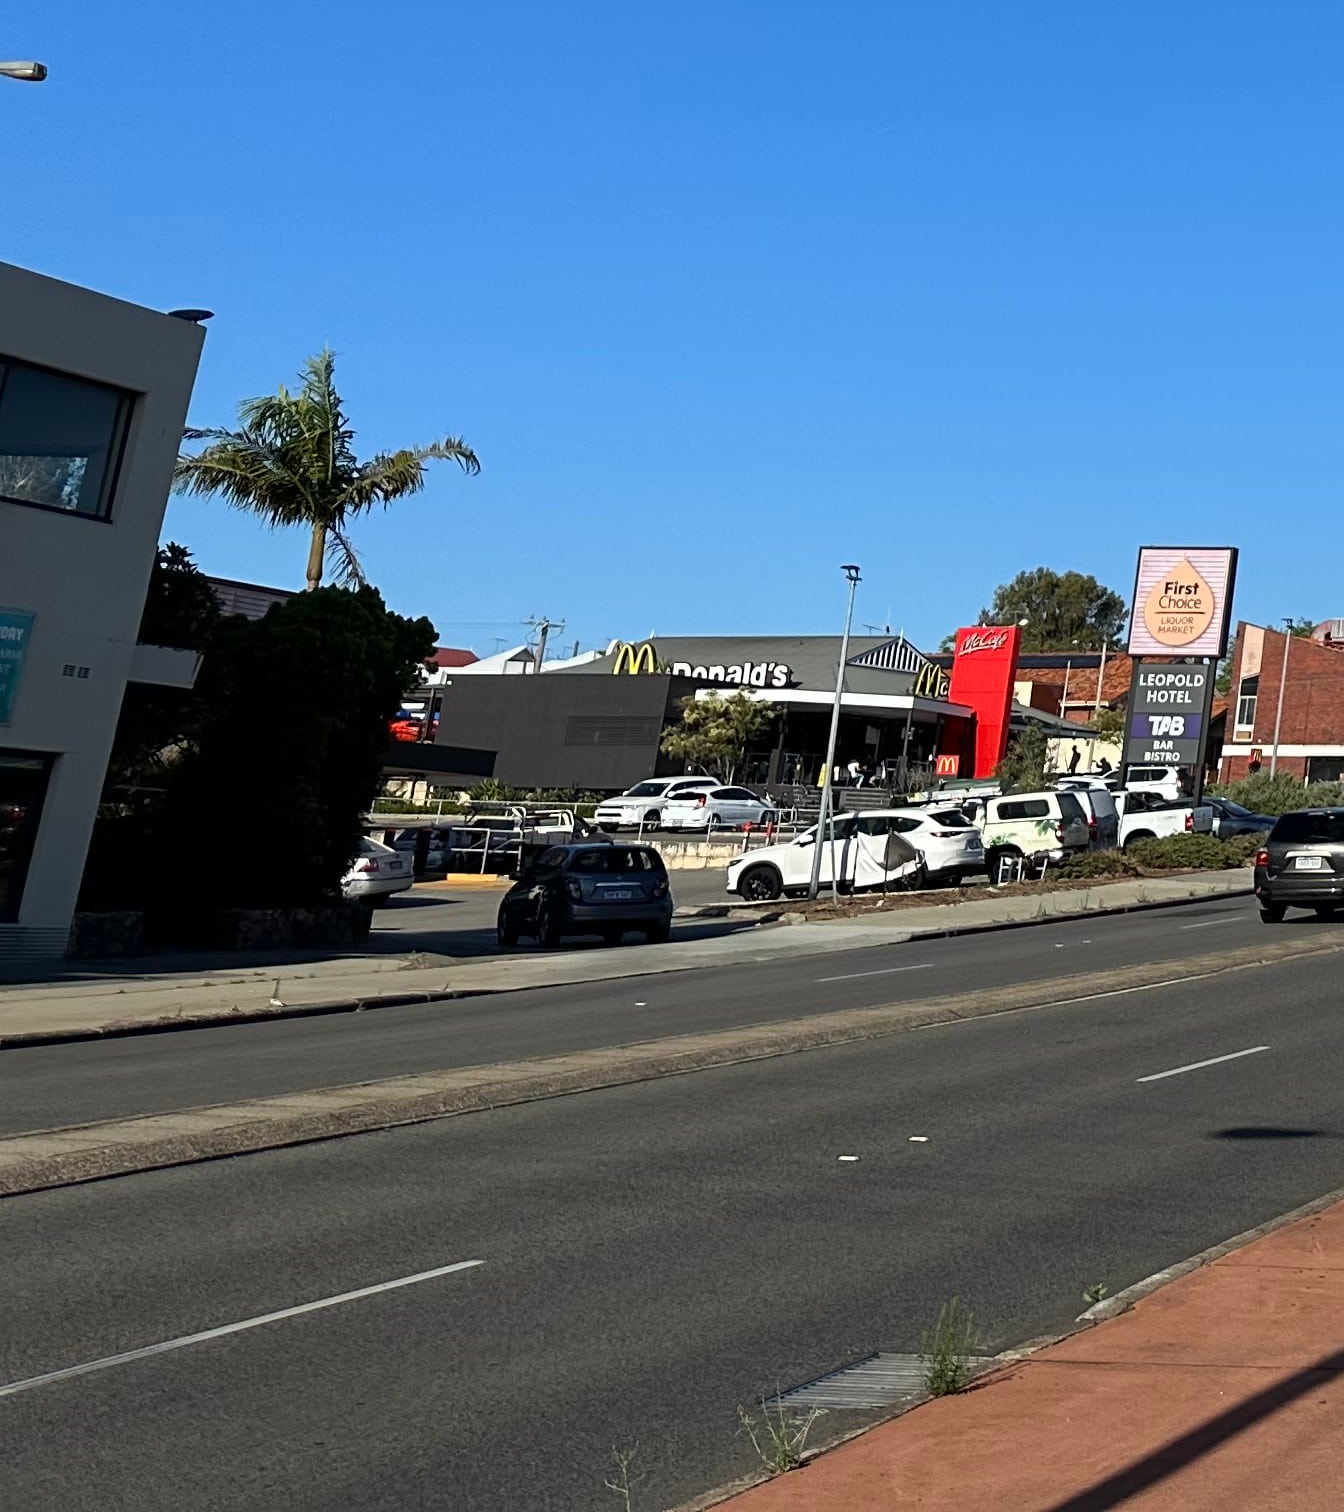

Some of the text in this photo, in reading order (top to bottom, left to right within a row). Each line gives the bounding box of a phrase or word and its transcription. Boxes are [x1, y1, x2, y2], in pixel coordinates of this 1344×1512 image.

[1164, 580, 1200, 595] First
[1158, 595, 1202, 609] Choice
[1161, 616, 1195, 625] LIQUOR
[1157, 625, 1195, 634] MARKET
[1139, 673, 1204, 687] LEOPOLD
[1146, 690, 1193, 704] HOTEL
[1148, 715, 1185, 736] TAB
[1153, 740, 1174, 750] BAR
[1143, 751, 1181, 762] BISTRO
